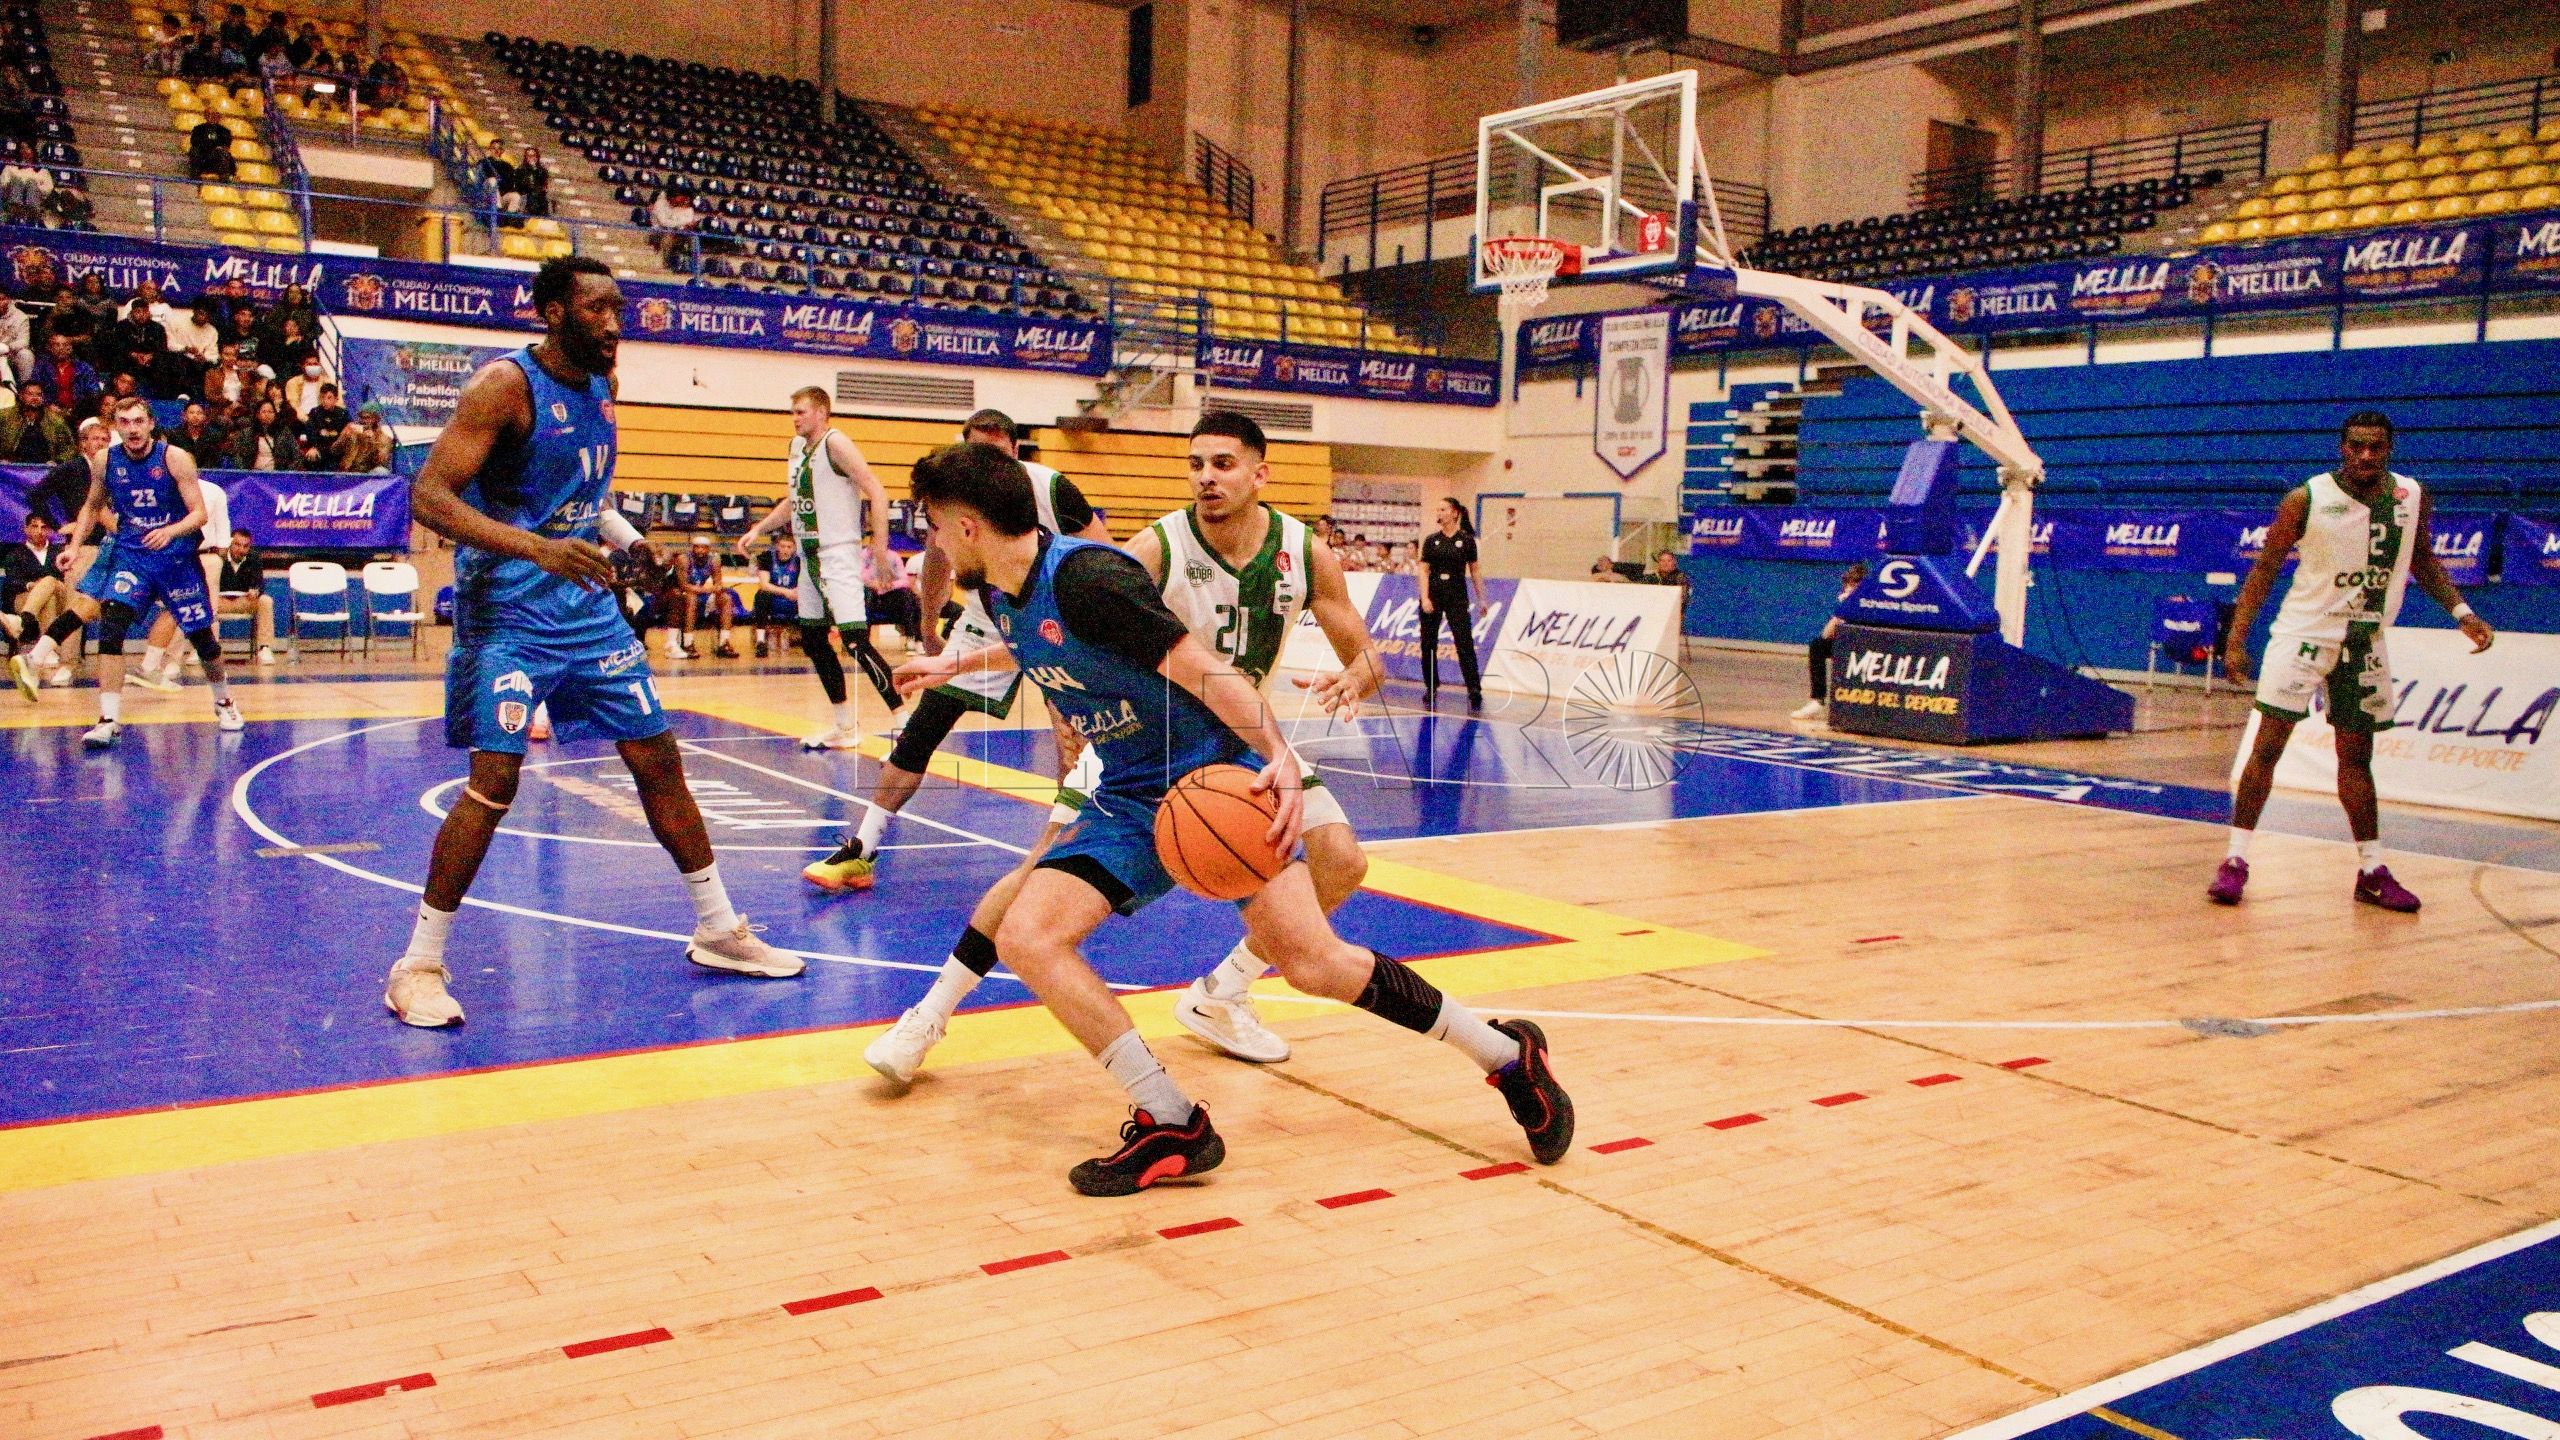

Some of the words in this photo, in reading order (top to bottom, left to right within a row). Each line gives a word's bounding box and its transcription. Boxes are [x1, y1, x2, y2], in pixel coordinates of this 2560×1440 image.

[2343, 230, 2468, 273] MELILLA
[2071, 262, 2170, 298] MELILLA
[2227, 268, 2323, 297] MELILLA
[394, 289, 494, 316] MELILLA
[1980, 292, 2057, 317] MELILLA
[680, 311, 766, 336] MELILLA
[782, 304, 875, 336] MELILLA
[926, 334, 1000, 356] MELILLA
[1013, 326, 1097, 353] MELILLA
[131, 488, 157, 508] 23
[275, 492, 376, 519] MELILLA
[2105, 523, 2181, 547] MELILLA
[2369, 522, 2387, 556] 2
[2334, 563, 2392, 590] coto
[178, 603, 207, 623] 23
[1215, 604, 1249, 657] 21
[1518, 609, 1642, 654] MELILLA
[1846, 649, 1950, 690] MELILLA
[1878, 692, 1900, 709] DEL
[1904, 694, 1960, 716] DEPORTE
[2391, 679, 2560, 745] LILLA
[2427, 744, 2530, 772] DEPORTE
